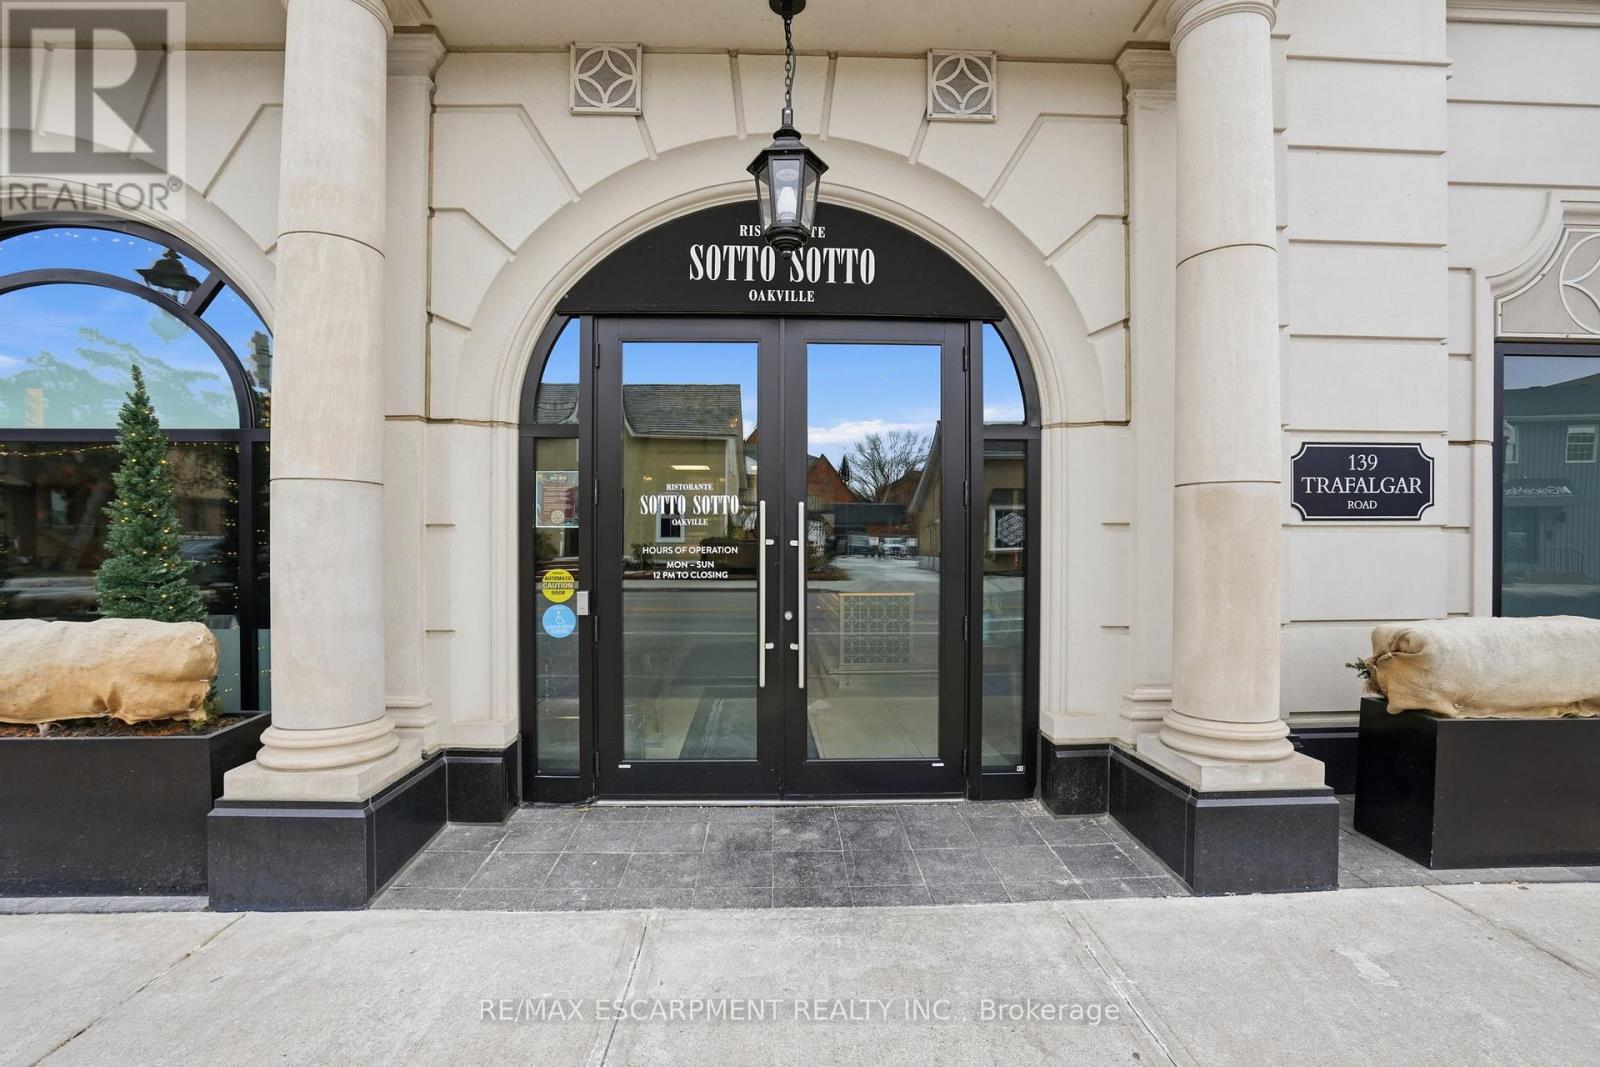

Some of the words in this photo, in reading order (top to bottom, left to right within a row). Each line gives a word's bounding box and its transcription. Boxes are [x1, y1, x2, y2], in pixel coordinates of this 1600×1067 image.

[739, 224, 826, 239] RISTE
[689, 244, 776, 282] SOTTO
[789, 246, 876, 285] SOTTO
[748, 289, 815, 302] OAKVILLE
[1348, 453, 1378, 471] 139
[666, 483, 714, 491] RISTORANTE
[1300, 476, 1423, 494] TRAFALGAR
[640, 494, 686, 515] SOTTO
[693, 494, 739, 515] SOTTO
[1347, 500, 1378, 509] ROAD
[671, 518, 709, 526] OAKVILLE
[642, 546, 673, 554] HOURS
[674, 546, 687, 554] OF
[688, 546, 738, 554] OPERATION
[666, 561, 688, 569] MON
[696, 561, 714, 569] SUN
[653, 571, 661, 579] 12
[662, 571, 676, 579] PM
[678, 571, 688, 579] TO
[690, 571, 728, 579] CLOSING
